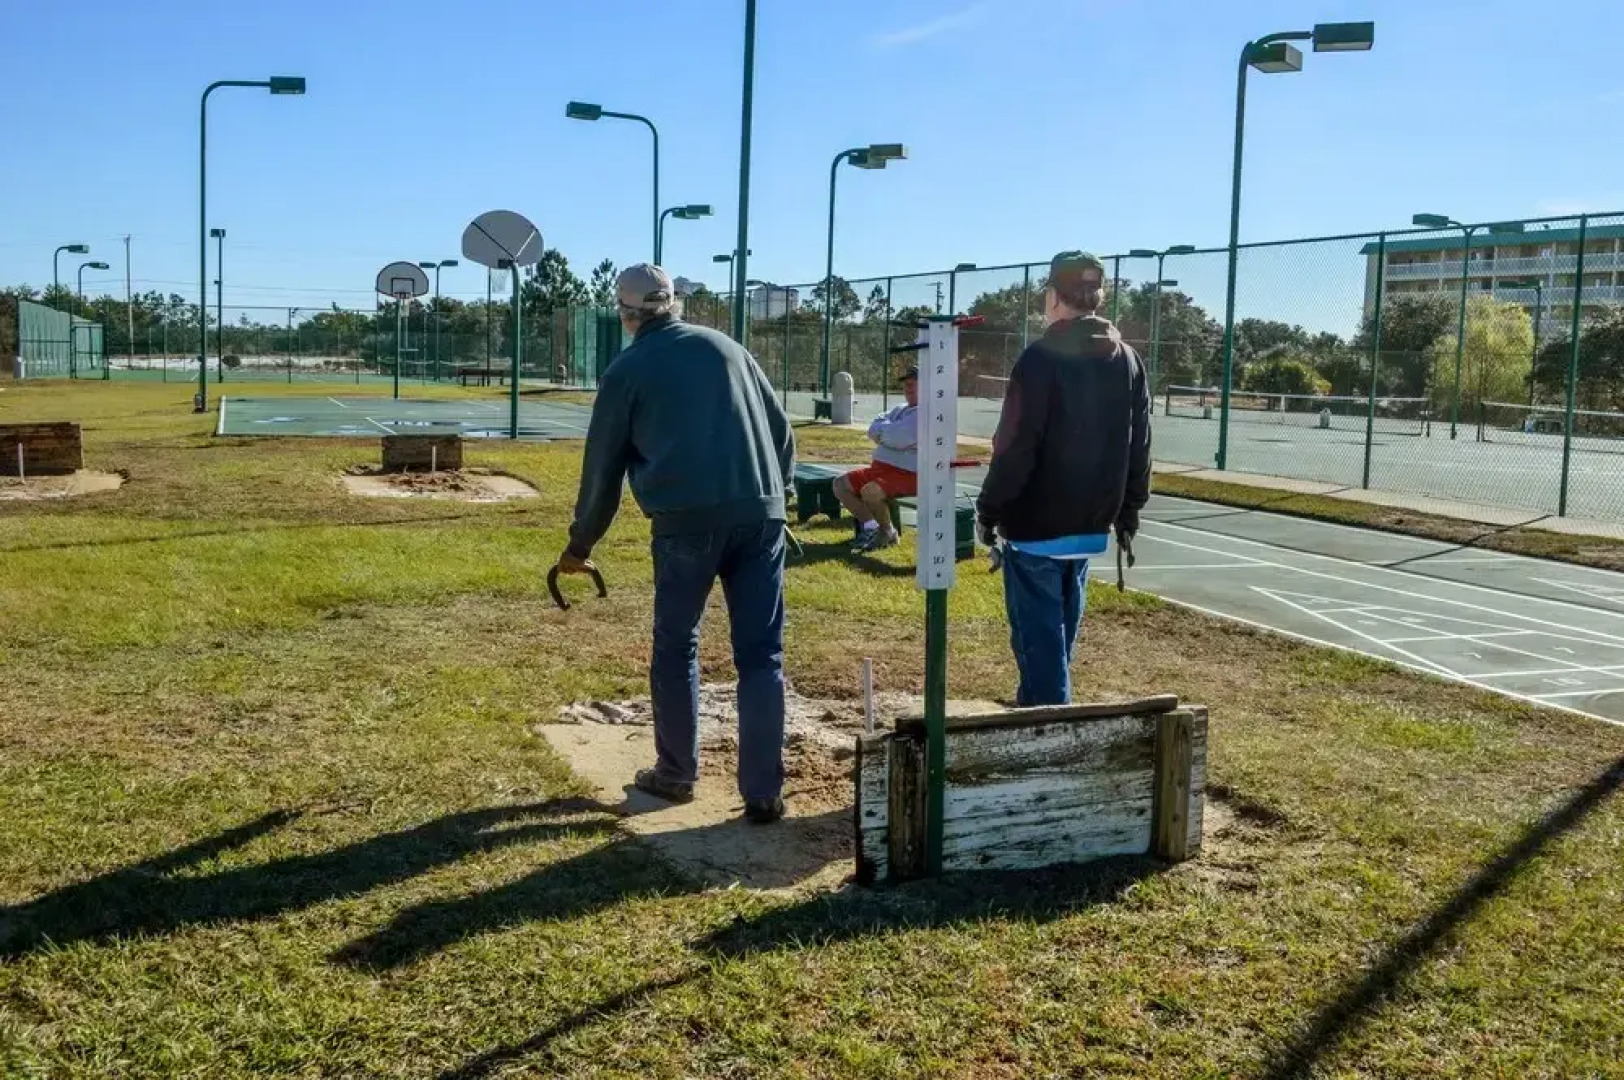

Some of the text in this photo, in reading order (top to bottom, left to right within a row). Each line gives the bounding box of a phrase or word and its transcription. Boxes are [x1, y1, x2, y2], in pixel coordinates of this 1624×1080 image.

[936, 365, 944, 374] 2
[936, 389, 944, 398] 3
[936, 413, 943, 422] 4
[936, 437, 943, 446] 5
